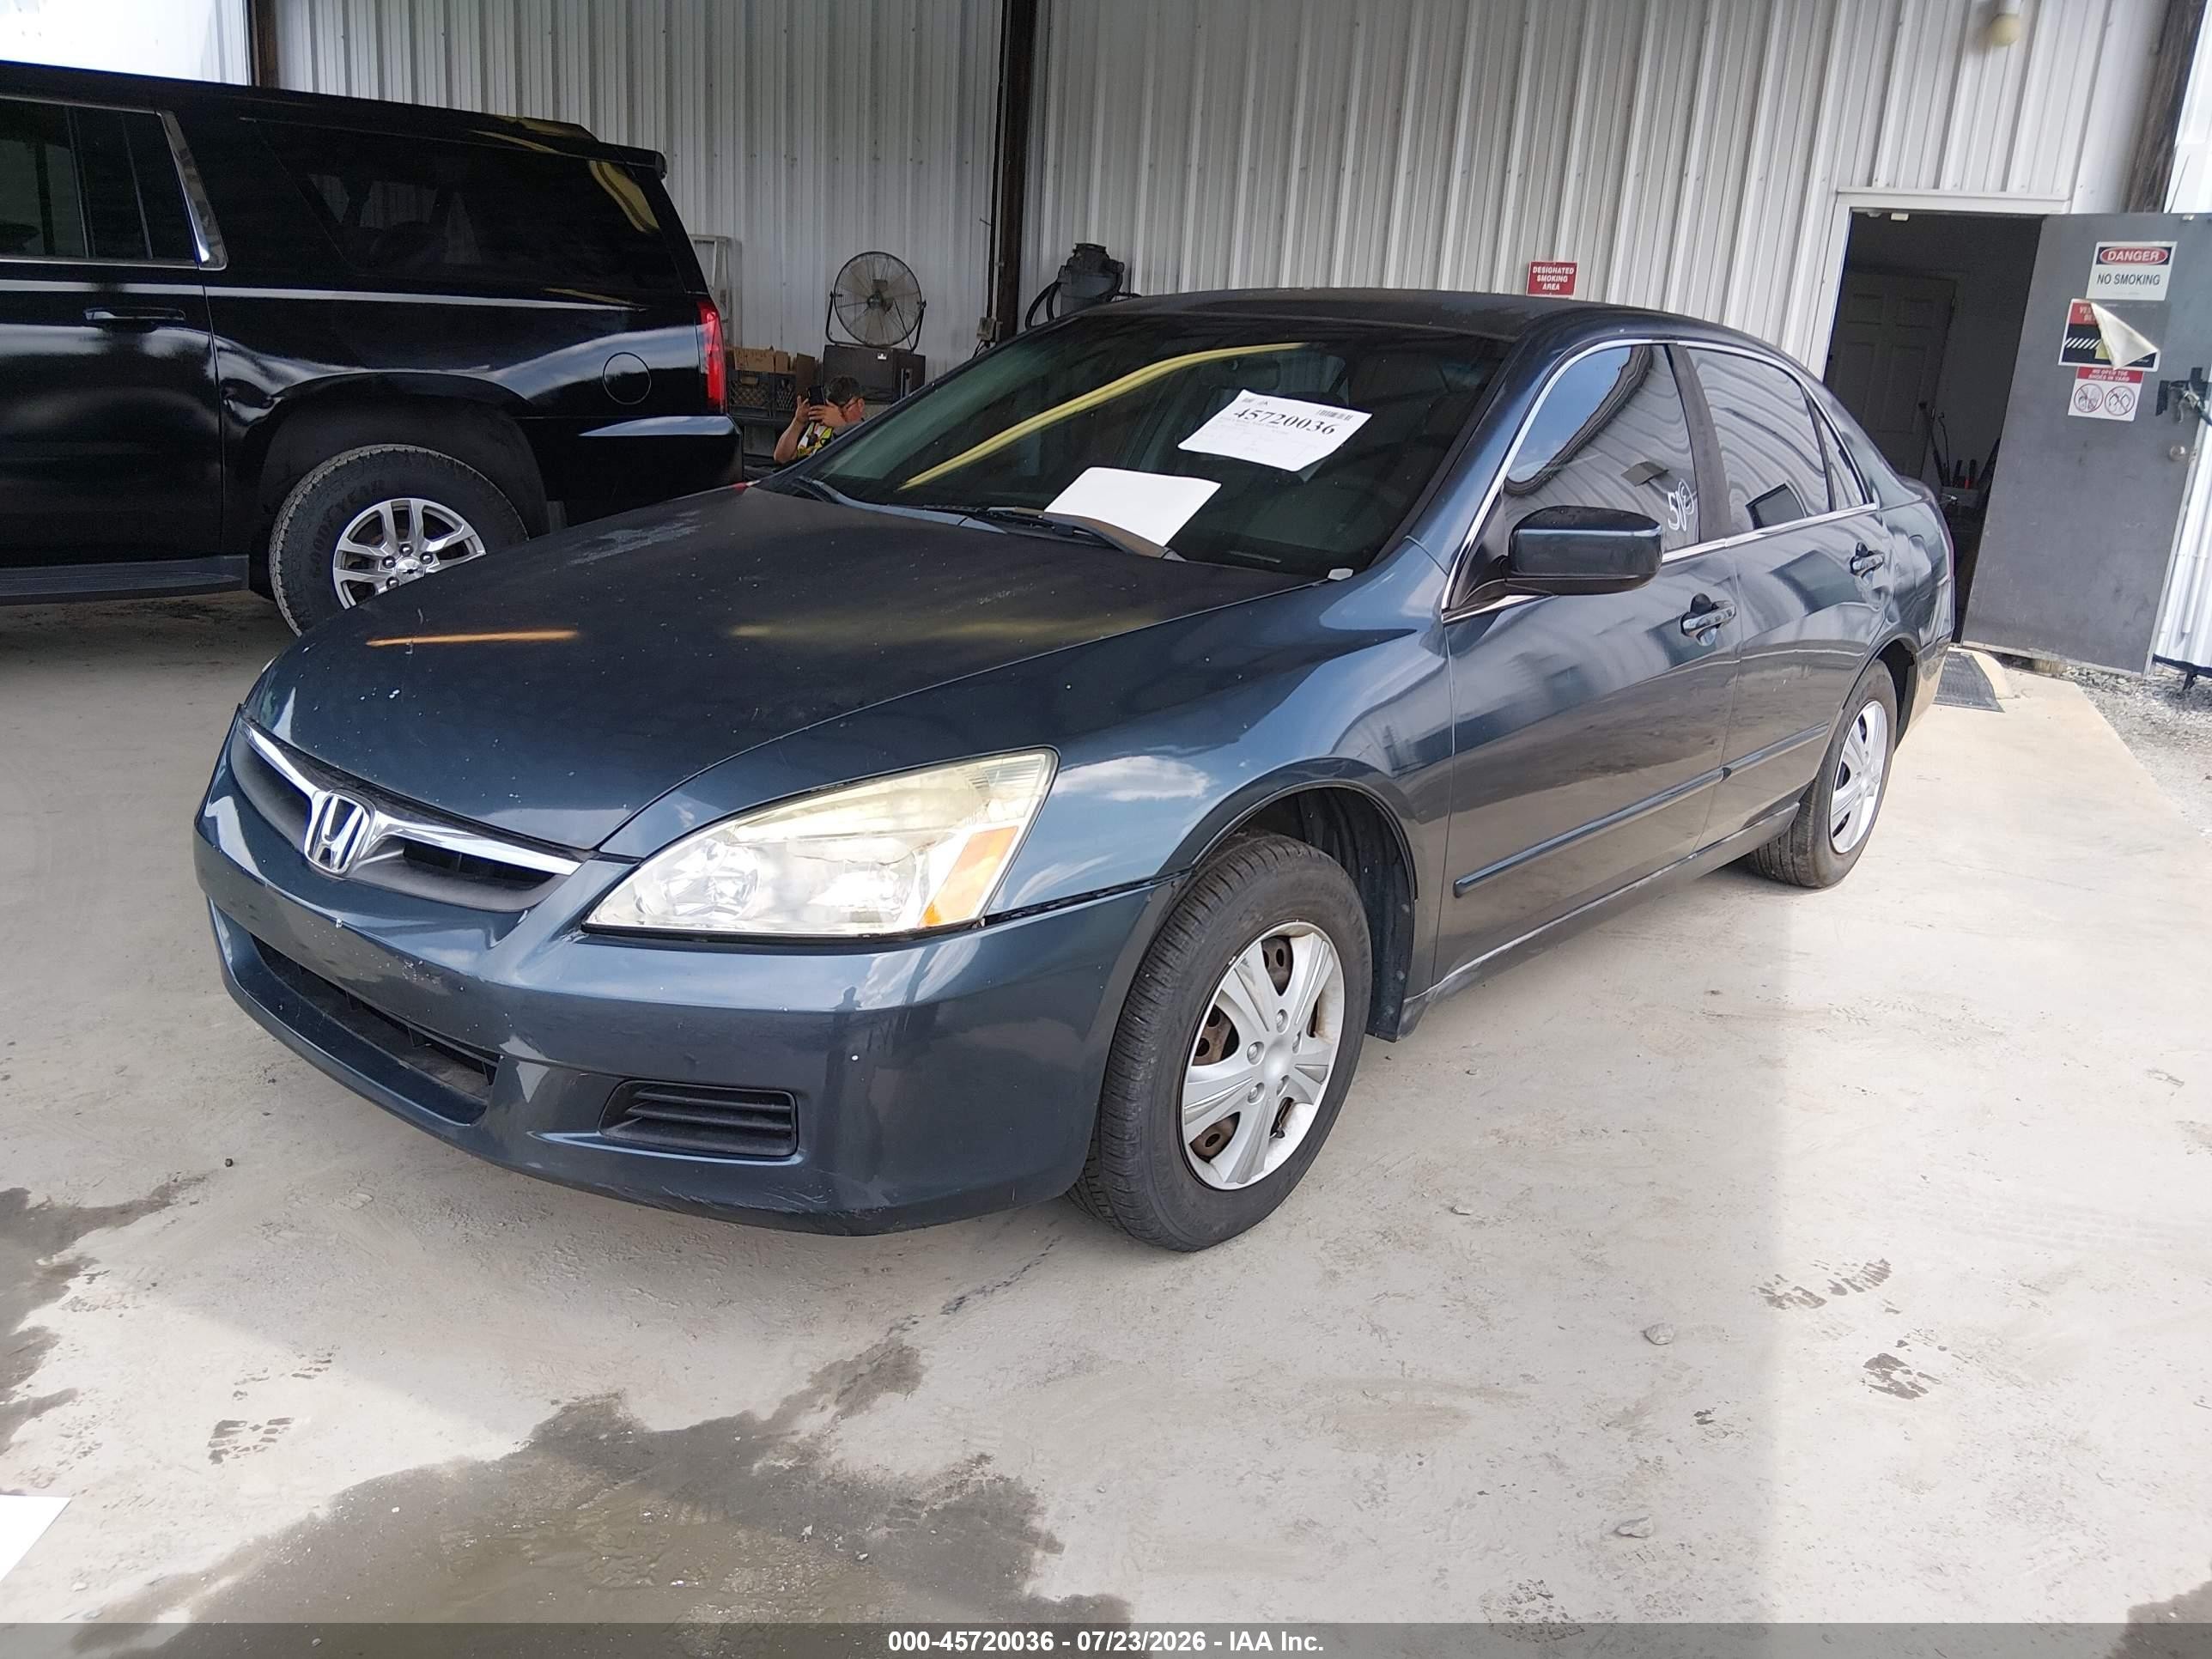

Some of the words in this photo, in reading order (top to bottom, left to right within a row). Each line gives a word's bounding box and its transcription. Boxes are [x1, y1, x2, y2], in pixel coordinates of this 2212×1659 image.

[2107, 251, 2160, 261] DANGER
[1532, 266, 1575, 275] DESIGNATED
[1536, 274, 1568, 283] SMOKING
[2097, 273, 2112, 285] NO
[2113, 274, 2161, 286] SMOKING
[1541, 283, 1560, 291] AREA
[1233, 408, 1335, 434] 45720036
